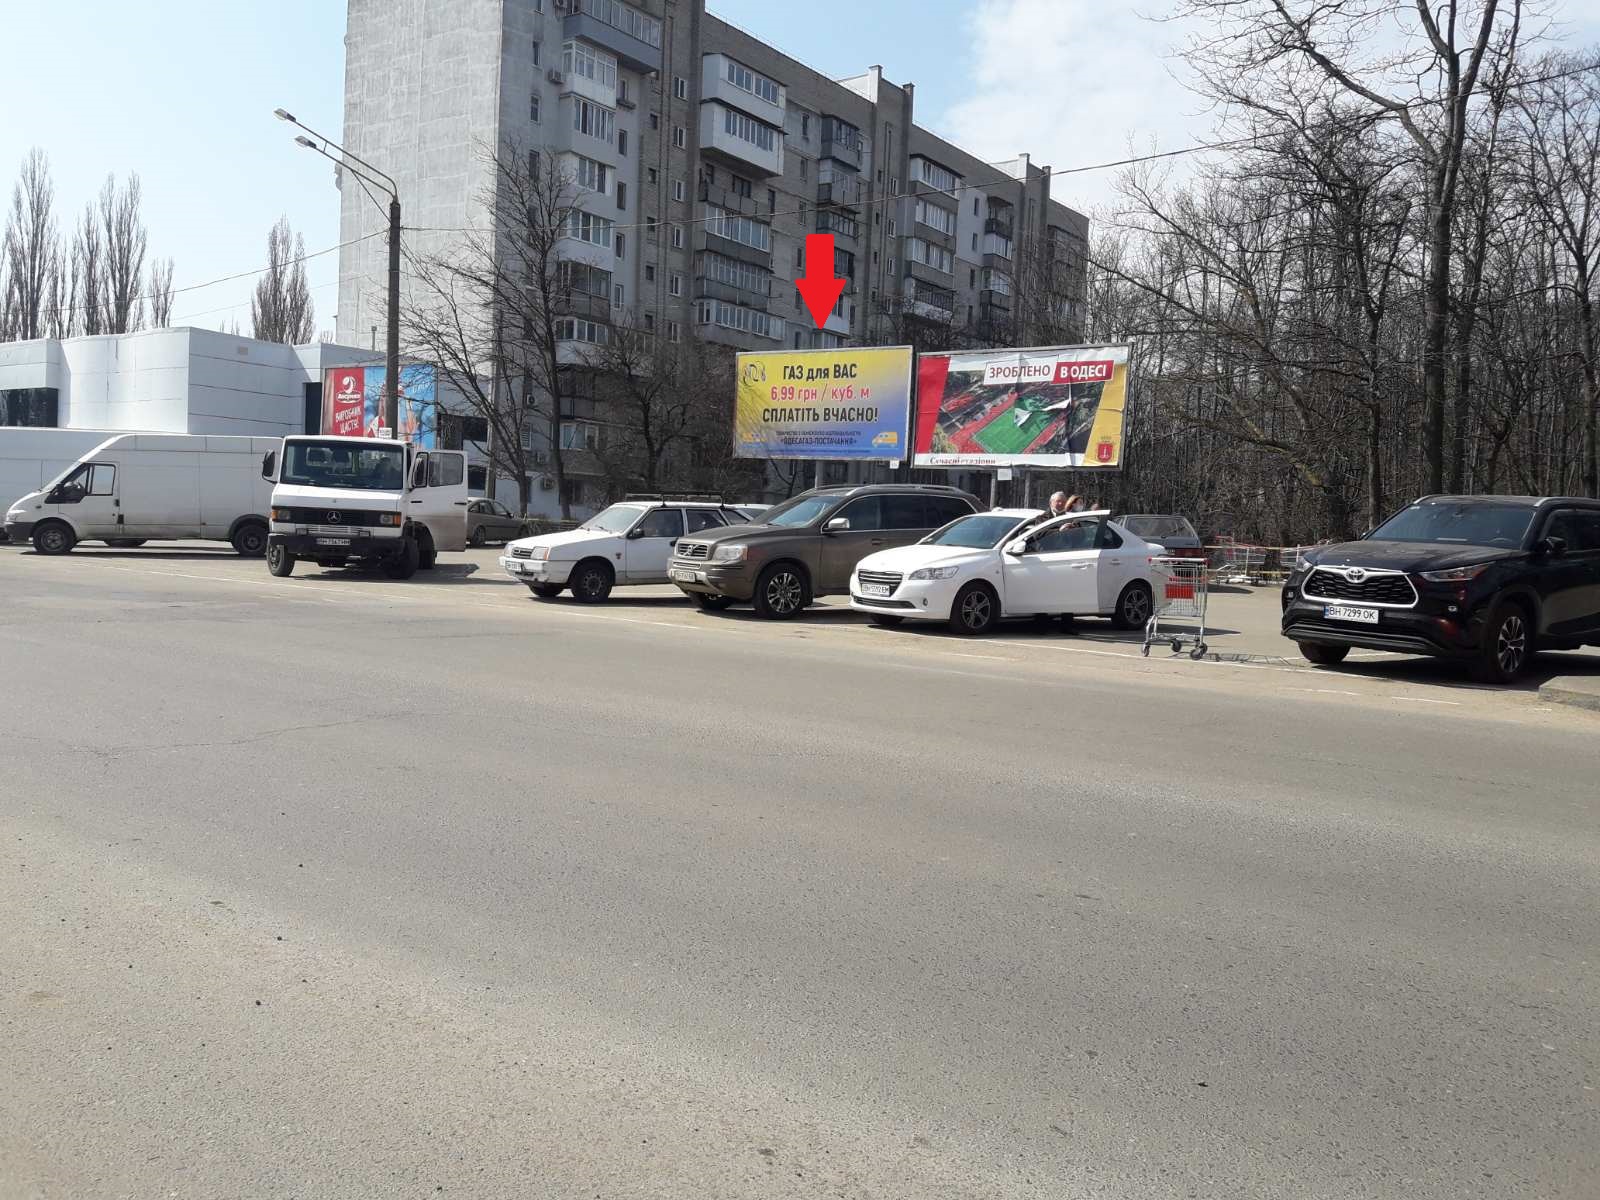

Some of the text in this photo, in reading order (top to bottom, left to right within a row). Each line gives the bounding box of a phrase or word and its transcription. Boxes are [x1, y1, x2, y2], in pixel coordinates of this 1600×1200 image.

[783, 363, 858, 382] ГАЗ для ВАС
[989, 364, 1051, 379] ЗРОБЛЕНО
[1060, 364, 1107, 380] В ОДЕСІ
[770, 383, 870, 404] 6,99 грн / куб. м
[762, 407, 879, 422] СПЛАТІТЬ ВЧАСНО!
[1343, 607, 1361, 618] 7299
